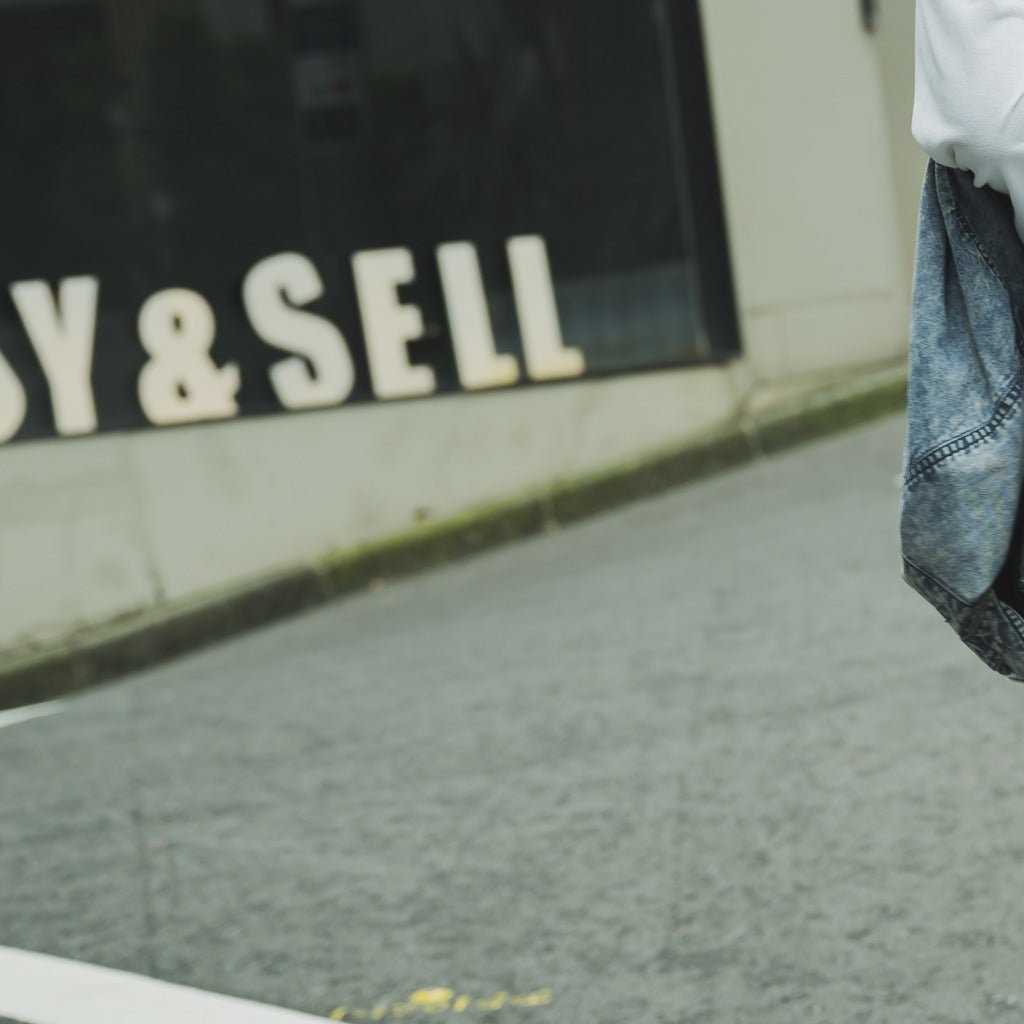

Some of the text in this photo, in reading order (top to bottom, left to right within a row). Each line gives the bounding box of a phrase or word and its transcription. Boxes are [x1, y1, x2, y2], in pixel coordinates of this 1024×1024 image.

[0, 234, 585, 445] Y & SELL
